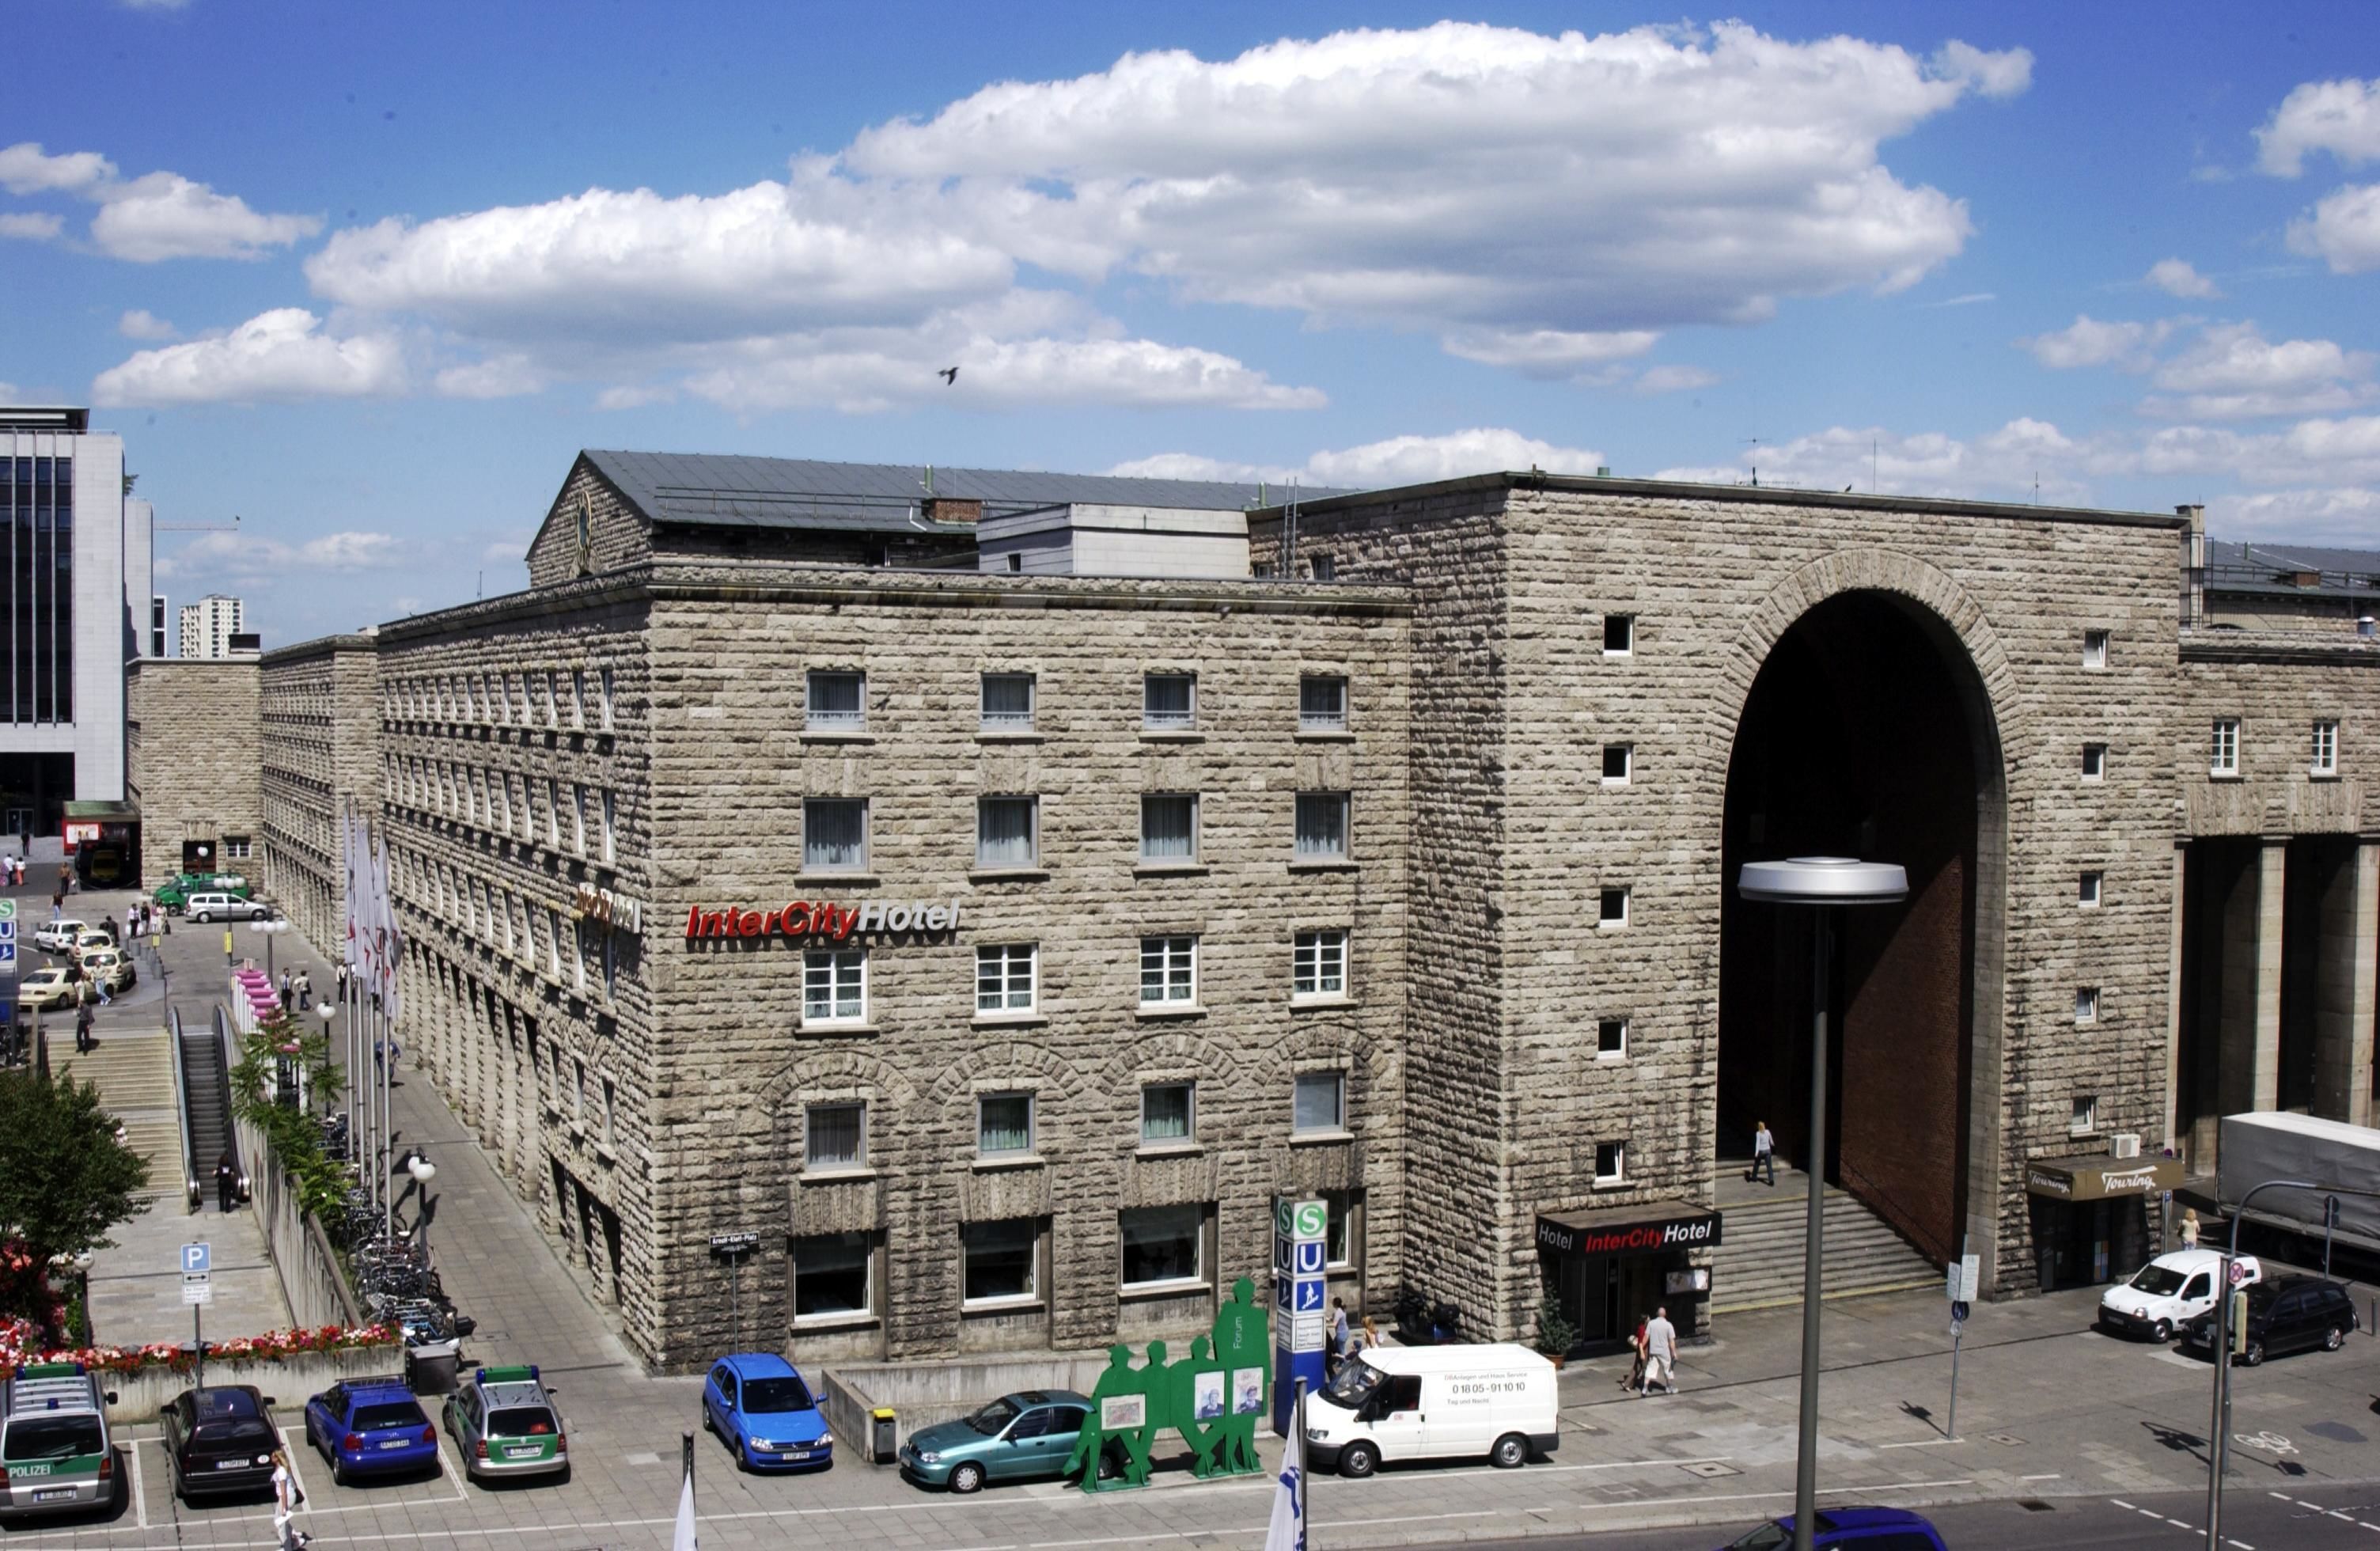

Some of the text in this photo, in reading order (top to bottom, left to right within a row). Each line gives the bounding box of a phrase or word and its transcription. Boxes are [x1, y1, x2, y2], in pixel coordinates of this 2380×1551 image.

[685, 899, 960, 940] InterCityHotel
[2028, 1170, 2070, 1193] Touring
[2101, 1165, 2158, 1193] Touring
[1281, 1205, 1290, 1230] S
[1302, 1208, 1320, 1232] S
[1539, 1224, 1572, 1250] Hotel
[1586, 1220, 1712, 1253] InterCityHotel
[188, 1247, 203, 1268] P
[1280, 1240, 1291, 1268] U
[1300, 1244, 1321, 1271] U
[1234, 1316, 1243, 1349] Forum
[9, 1464, 51, 1478] POLIZEI
